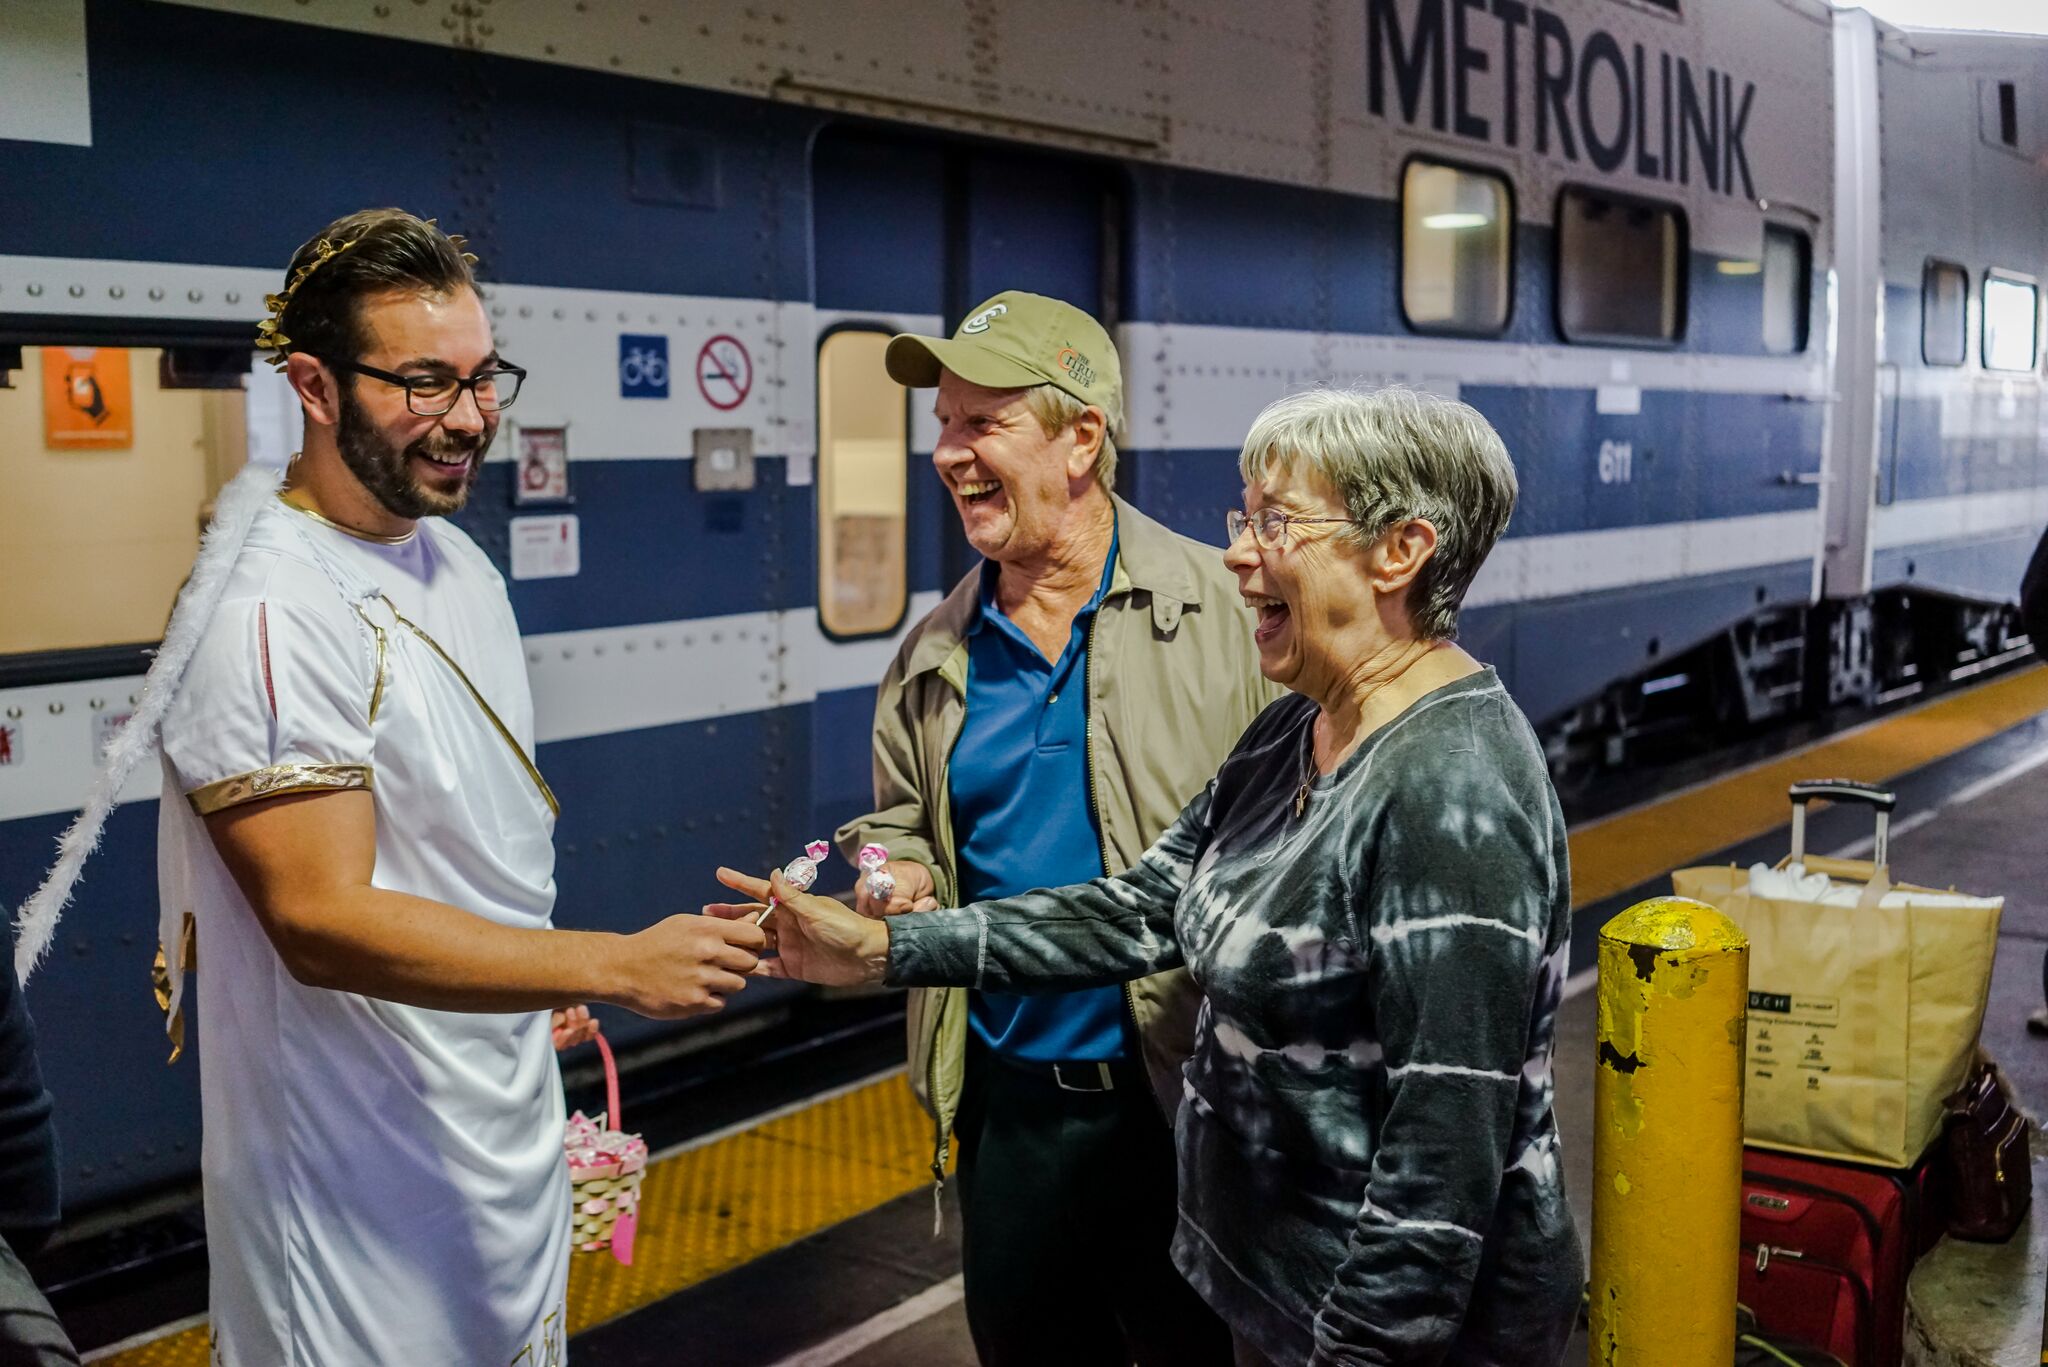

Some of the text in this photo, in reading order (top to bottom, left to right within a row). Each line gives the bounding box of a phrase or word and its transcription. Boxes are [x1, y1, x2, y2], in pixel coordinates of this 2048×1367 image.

[1367, 0, 1757, 200] METROLINK
[1056, 348, 1097, 384] CITRUS
[1076, 353, 1089, 366] THE
[1068, 370, 1090, 388] CLUB
[1599, 440, 1632, 483] 611
